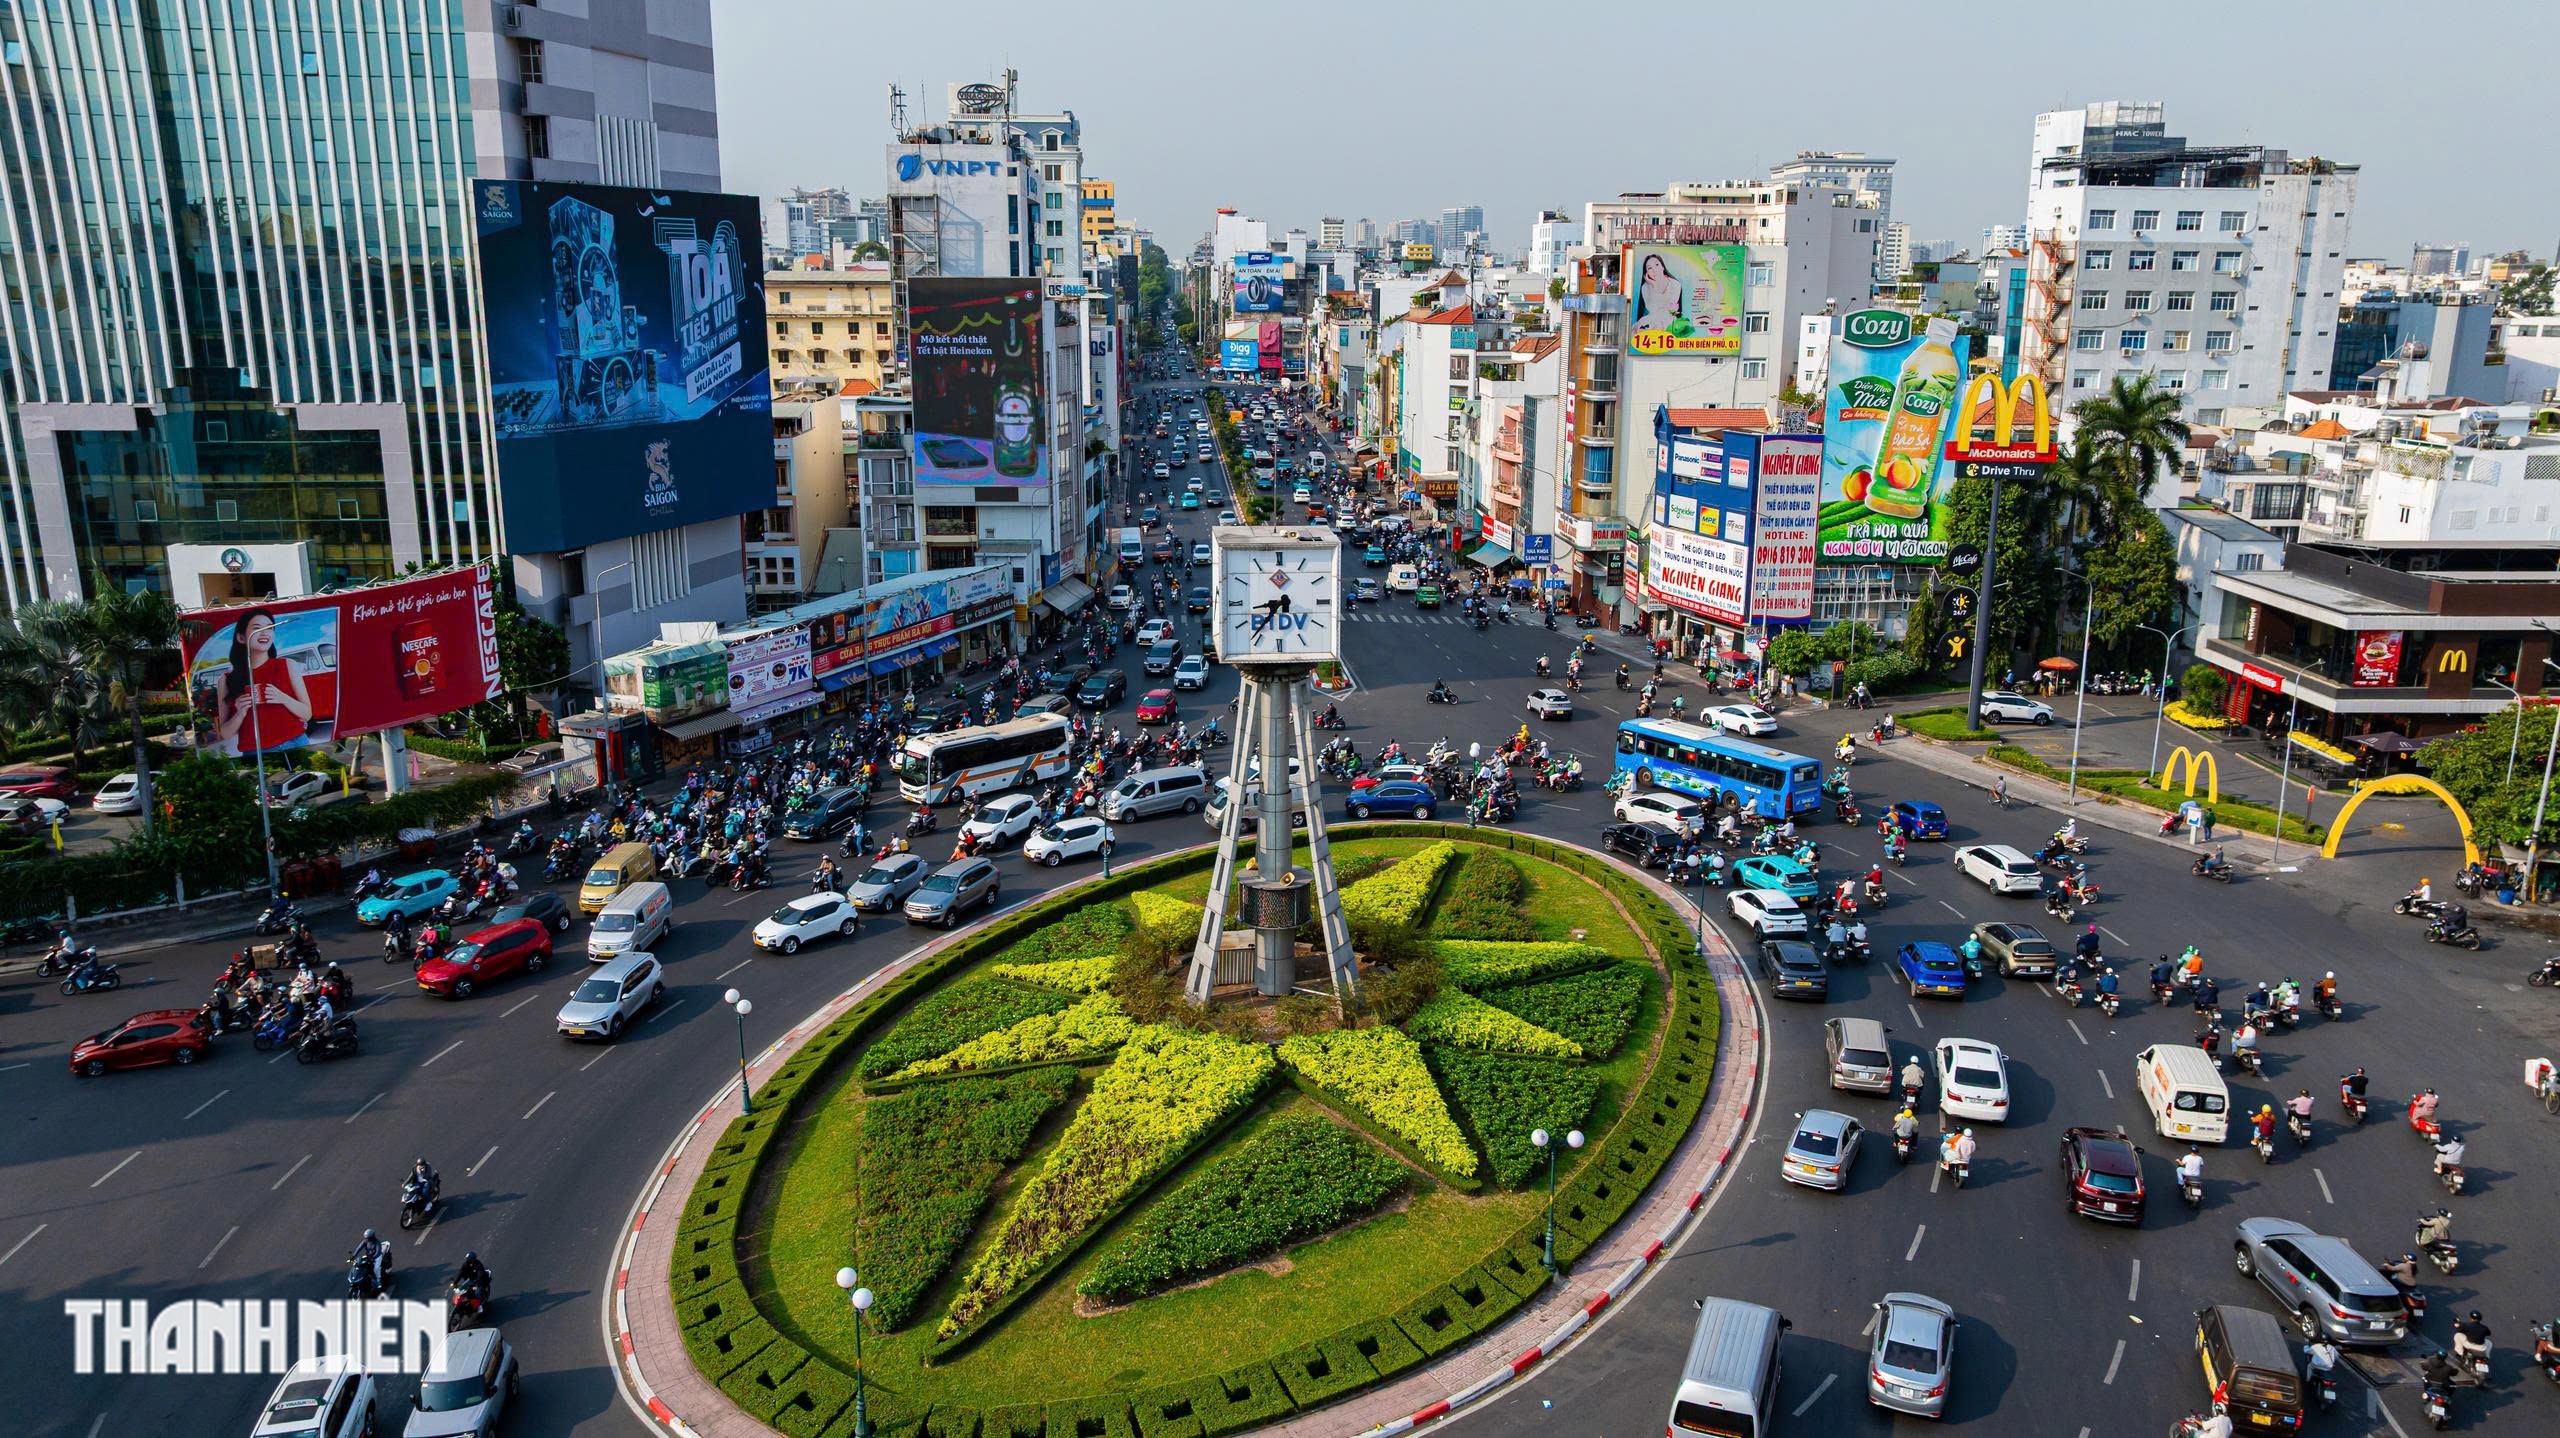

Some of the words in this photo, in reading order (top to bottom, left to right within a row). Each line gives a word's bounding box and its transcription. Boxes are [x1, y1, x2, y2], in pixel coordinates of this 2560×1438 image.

[928, 160, 1002, 176] VNPT
[713, 295, 736, 327] VUI
[1851, 316, 1903, 340] Cozy
[920, 334, 935, 344] Mở
[936, 334, 950, 344] kết
[952, 334, 966, 344] nối
[967, 335, 988, 345] thật
[1635, 335, 1674, 349] 14-16
[916, 346, 931, 355] Tết
[933, 346, 948, 356] bật
[949, 346, 993, 355] Heineken
[1905, 395, 1939, 414] Cozy
[1675, 453, 1699, 464] Panasonic
[1968, 449, 2036, 459] McDonald's
[1796, 454, 1820, 475] GIANG
[1982, 466, 2010, 475] Drive
[2013, 466, 2035, 475] Thru
[655, 483, 666, 492] BIA
[644, 490, 678, 507] SAIGON
[1671, 504, 1695, 518] Schneider
[1702, 516, 1716, 524] MPE
[1807, 518, 1815, 527] TAY
[1848, 520, 1870, 538] TRÀ
[1873, 524, 1897, 538] HOA
[1901, 518, 1928, 538] QUẢ
[1765, 531, 1808, 540] HOTLINE:
[1798, 546, 1813, 564] 300
[1825, 542, 1851, 555] NGON
[1856, 539, 1870, 555] RÕ
[1872, 542, 1882, 557] VỊ
[1887, 543, 1899, 558] VỊ
[1902, 539, 1917, 554] RÕ
[1919, 543, 1947, 555] NGON
[1664, 551, 1680, 562] TRUNG
[1716, 552, 1726, 560] LED
[1708, 580, 1742, 603] GIANG
[353, 604, 377, 622] Khơi
[380, 600, 395, 616] mở
[397, 596, 414, 613] thế
[416, 593, 434, 612] giới
[453, 587, 466, 600] bạn
[1252, 614, 1308, 630] BIDV
[795, 634, 808, 647] 7K
[788, 664, 808, 684] 7K
